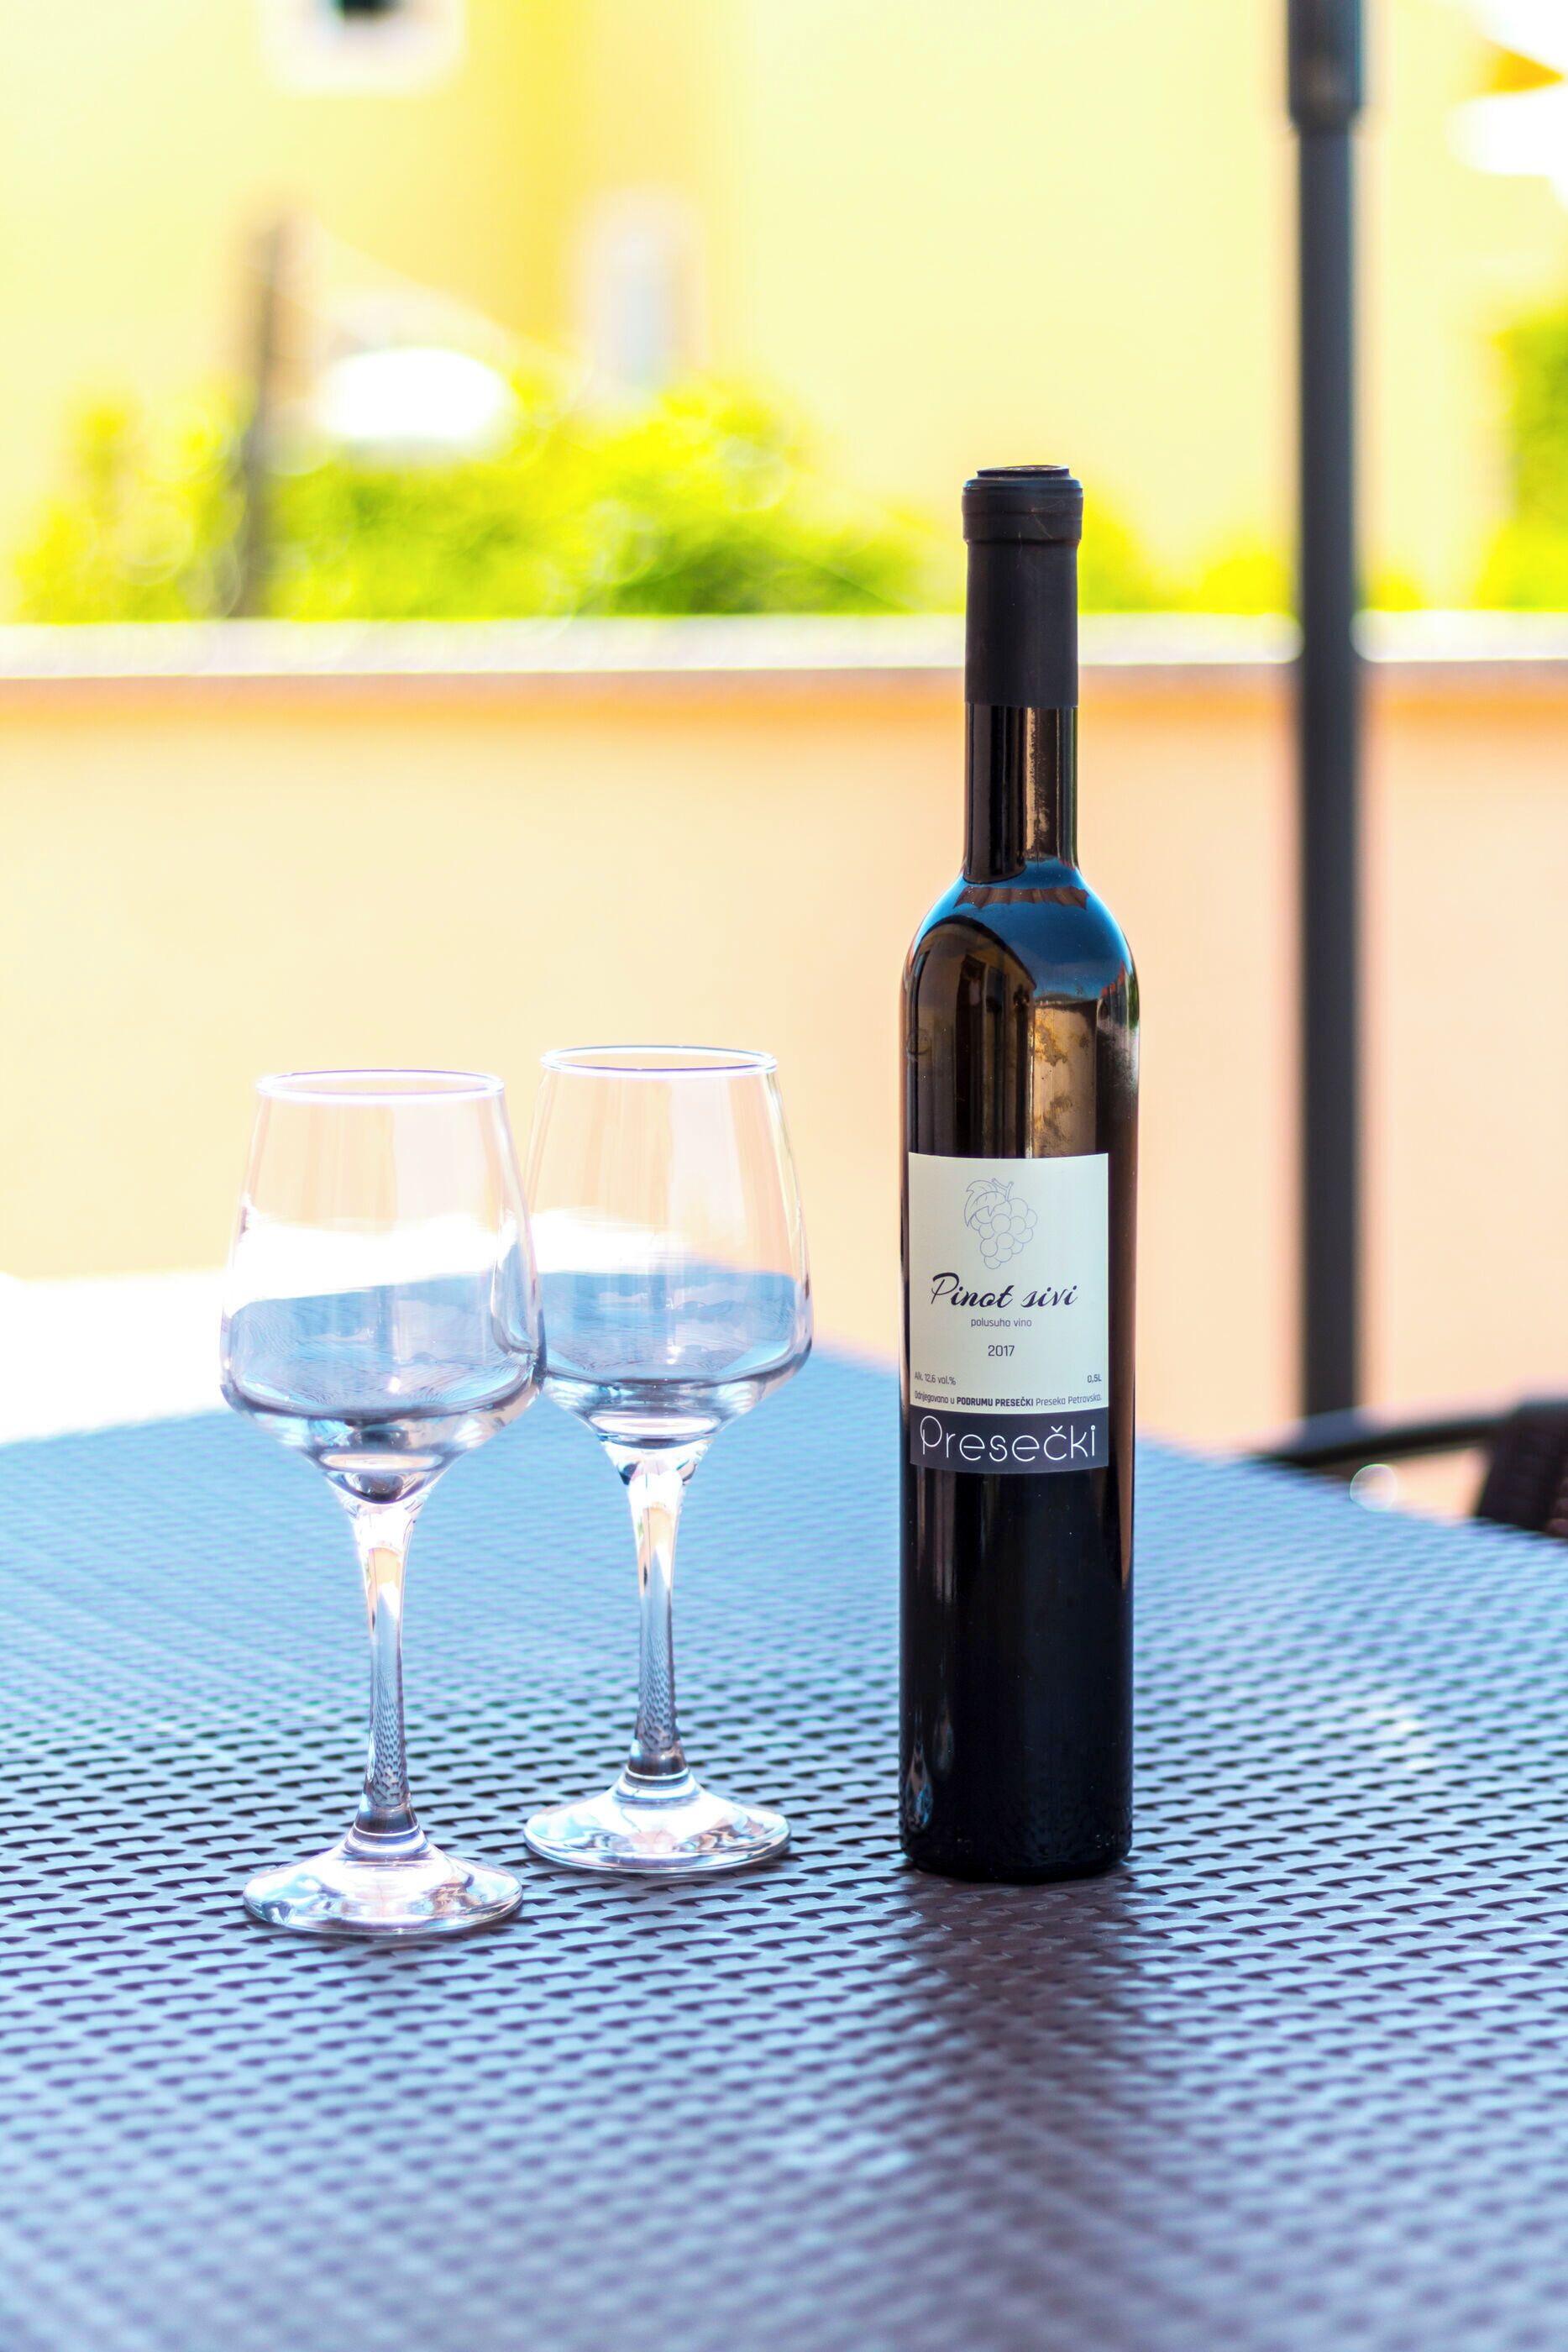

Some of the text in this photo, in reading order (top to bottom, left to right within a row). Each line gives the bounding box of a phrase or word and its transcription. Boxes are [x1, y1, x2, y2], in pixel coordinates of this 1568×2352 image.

[931, 1272, 1078, 1309] Pinot sivi
[970, 1317, 1032, 1328] polusuho vino
[988, 1345, 1015, 1357] 2017
[1087, 1373, 1102, 1383] 0,5L
[957, 1396, 994, 1407] PODRUMU
[994, 1396, 1034, 1407] PRESEČKI
[1036, 1396, 1066, 1406] Preseka
[920, 1415, 1096, 1462] Presečki
